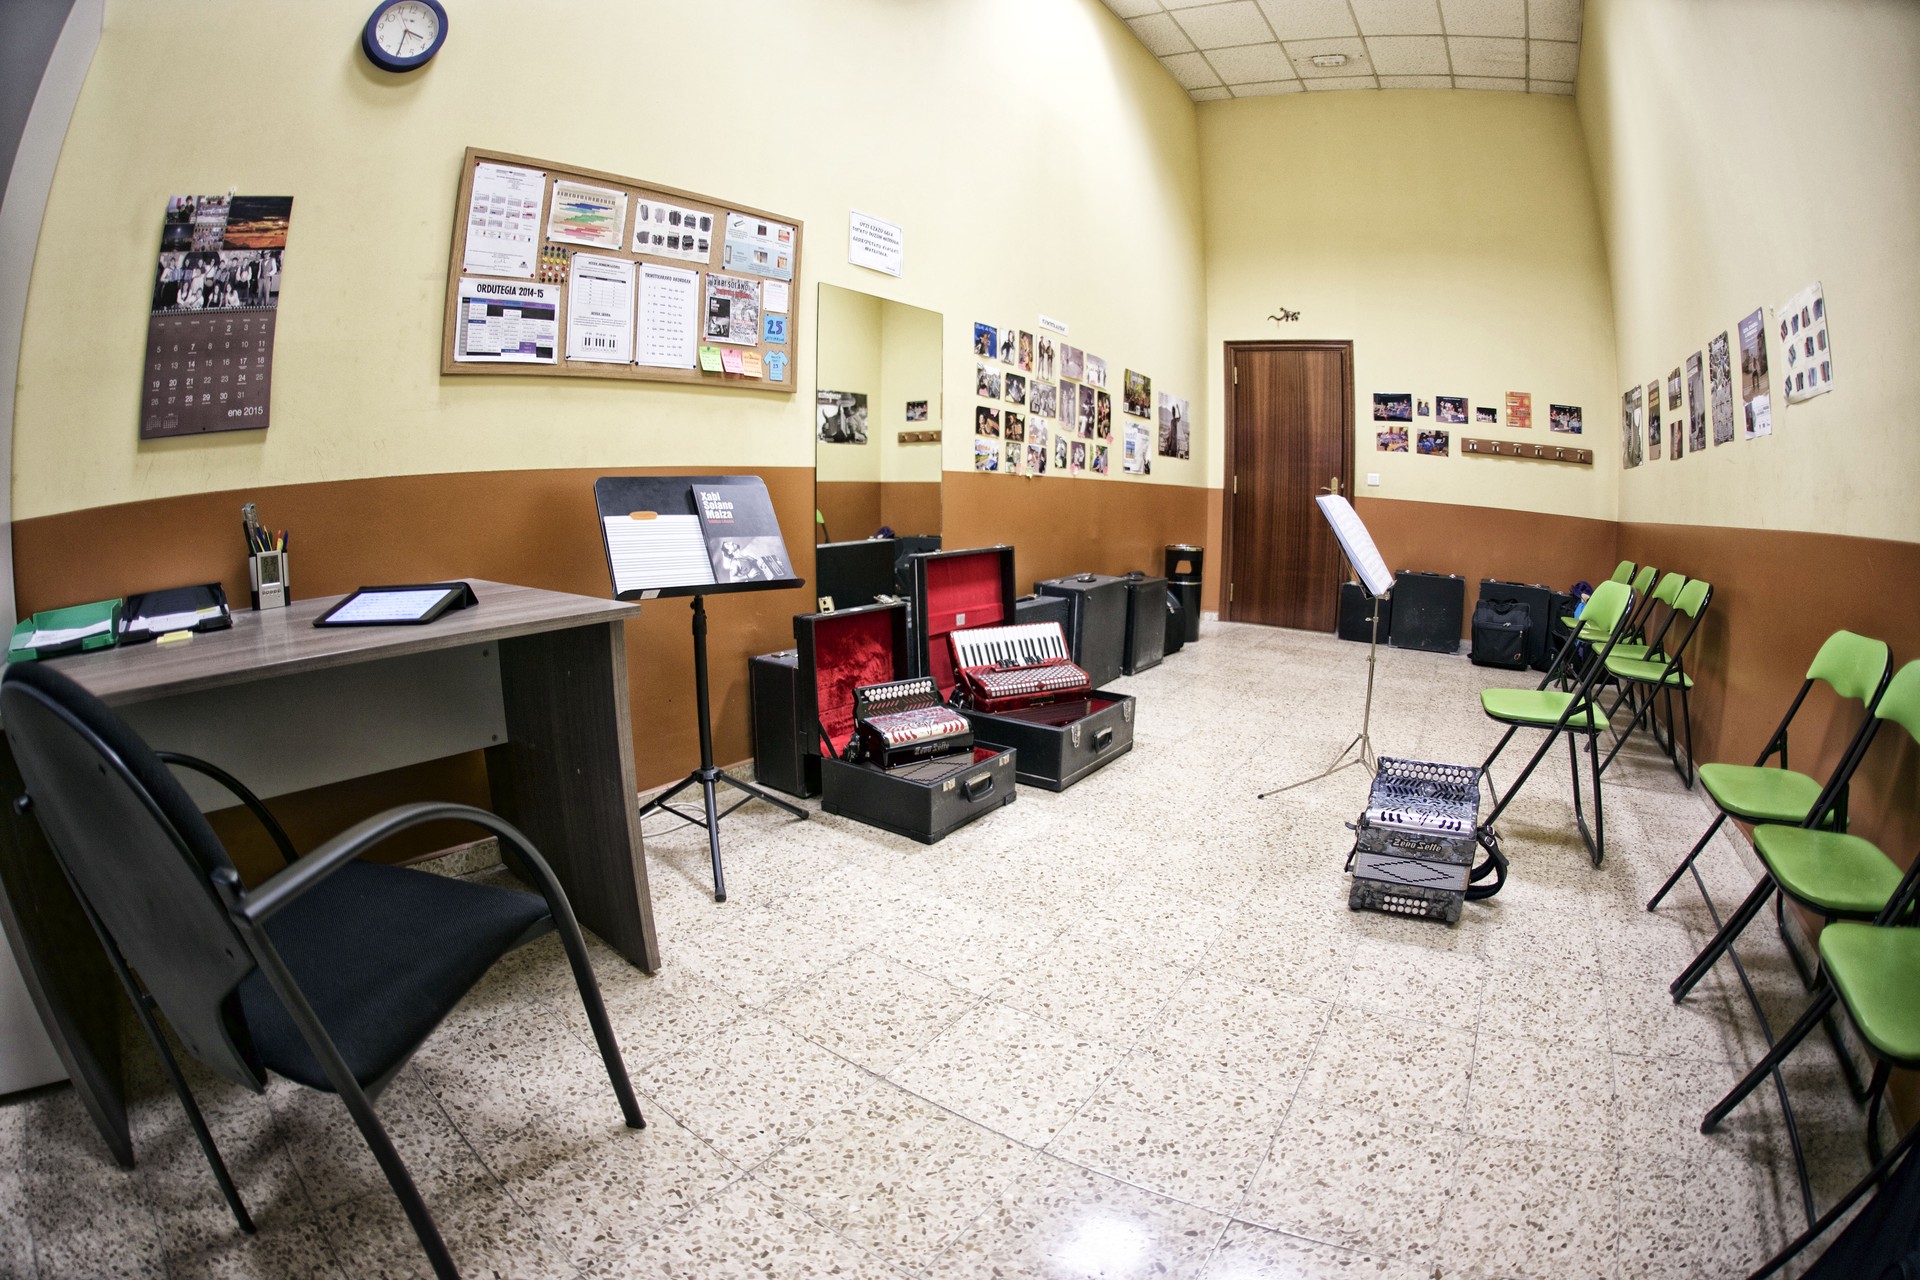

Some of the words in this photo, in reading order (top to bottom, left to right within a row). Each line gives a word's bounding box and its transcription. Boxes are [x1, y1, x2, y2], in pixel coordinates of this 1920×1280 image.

[408, 5, 418, 14] 12
[384, 14, 395, 22] 10
[378, 23, 384, 31] 9
[476, 284, 516, 295] ORDUTEGIA
[519, 287, 544, 298] 2014-15
[767, 319, 782, 335] 25
[228, 408, 242, 417] ene
[244, 406, 263, 416] 2015
[700, 491, 720, 500] Xabi
[703, 500, 733, 510] Solano
[705, 510, 733, 519] Maiza
[1393, 838, 1417, 848] Zero
[1417, 841, 1442, 852] Sette
